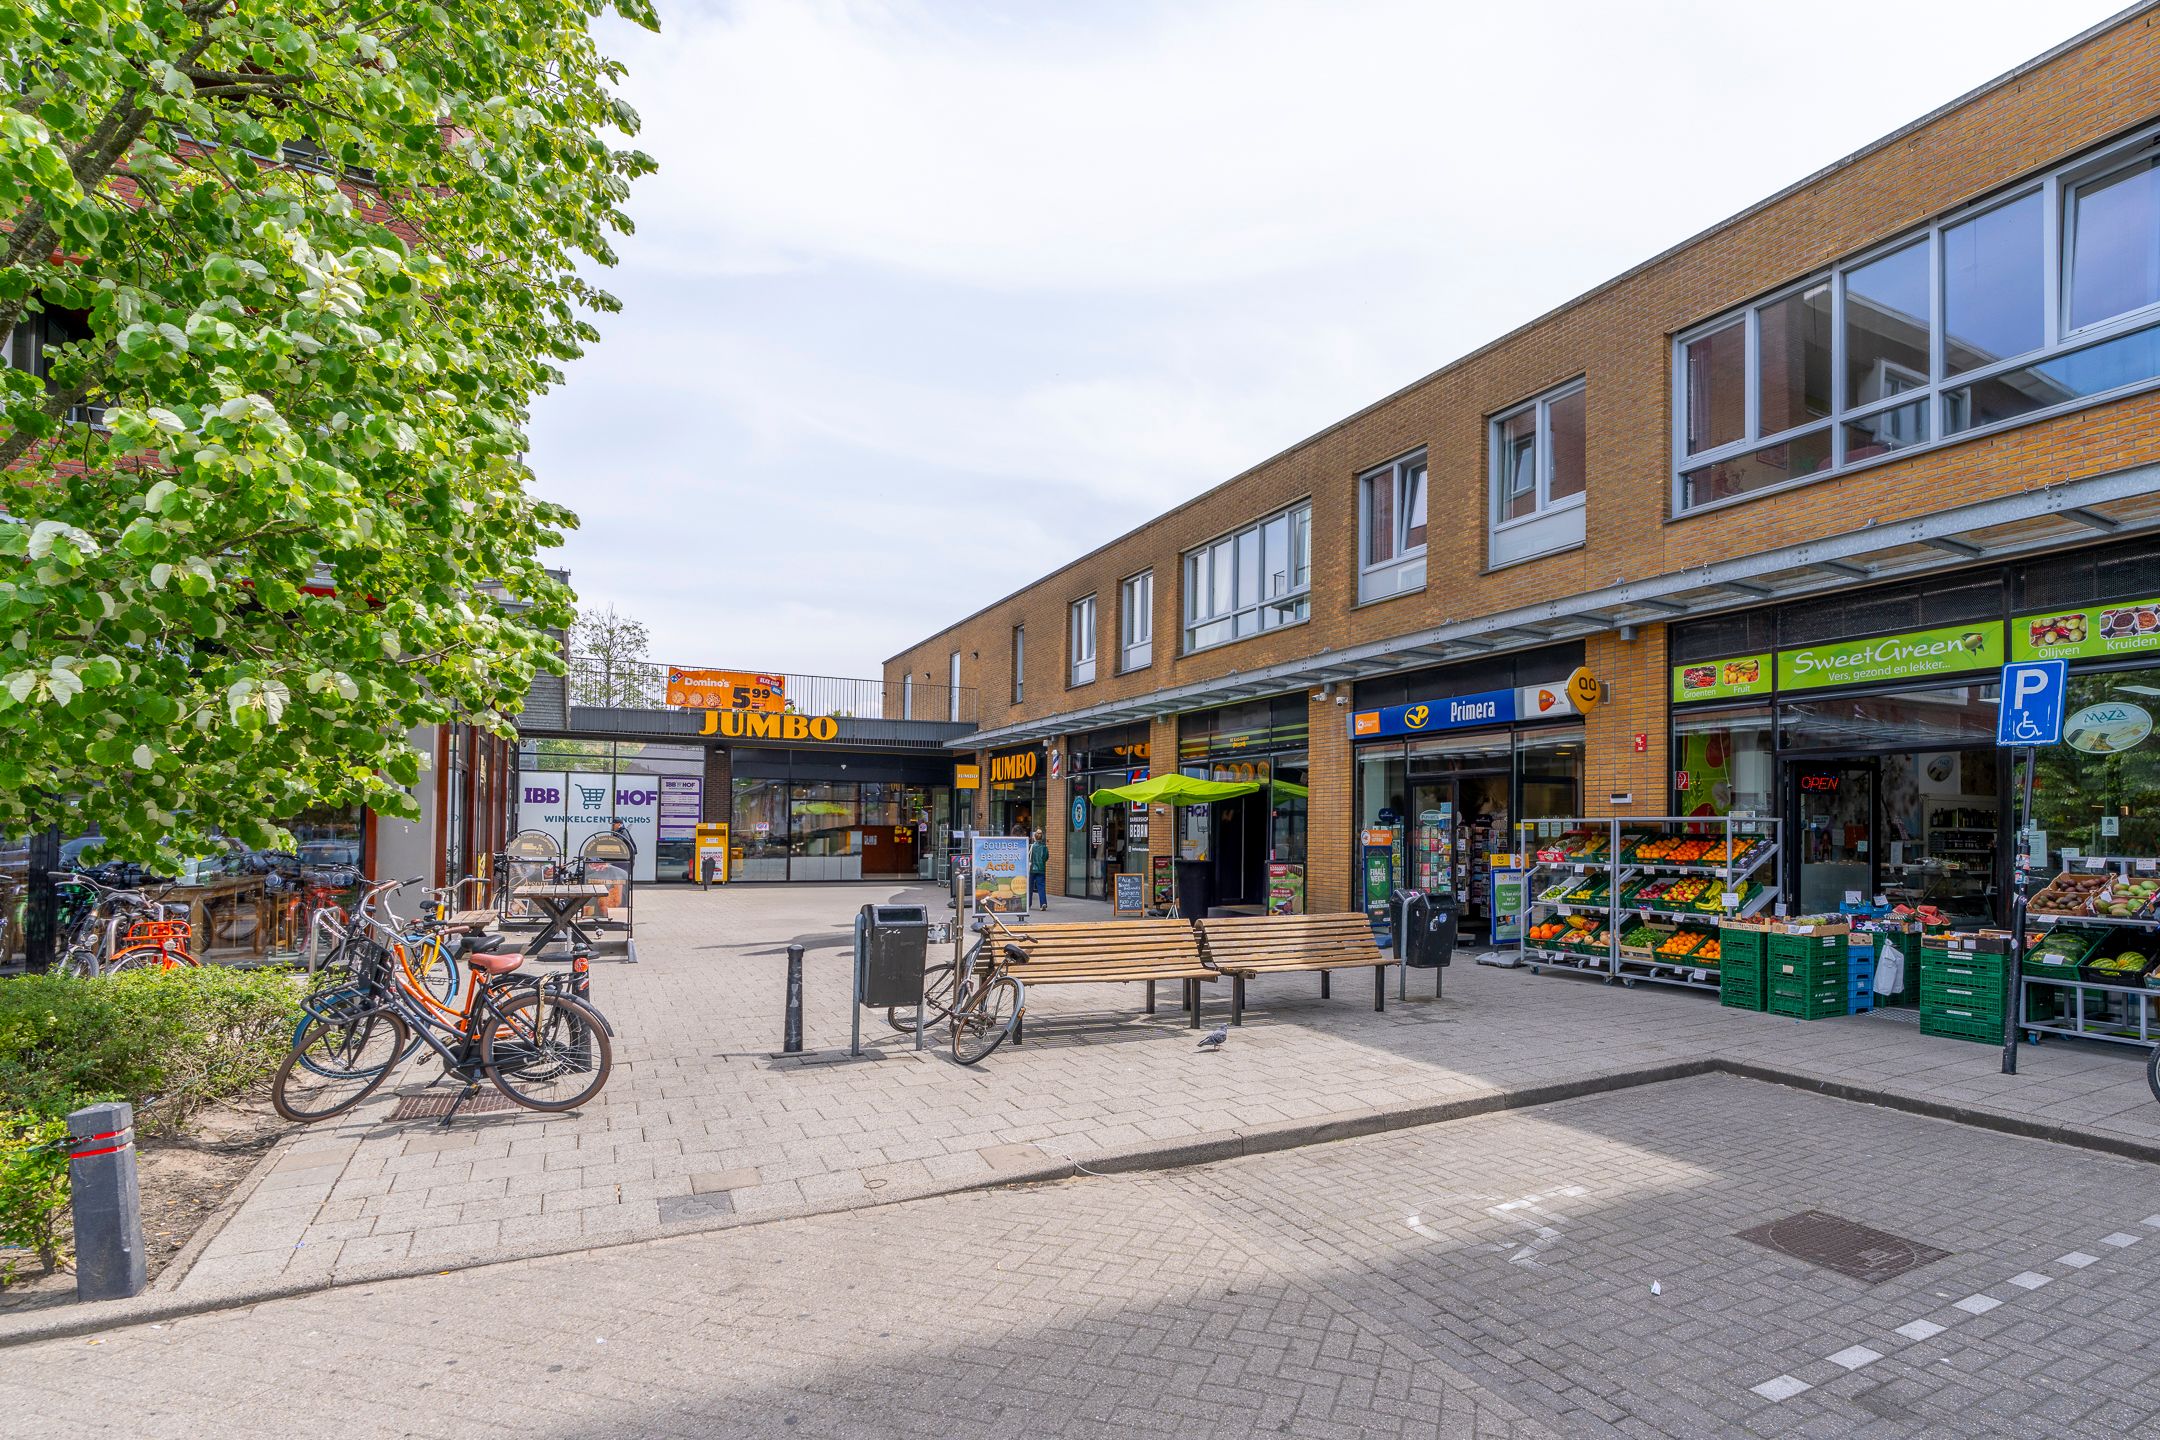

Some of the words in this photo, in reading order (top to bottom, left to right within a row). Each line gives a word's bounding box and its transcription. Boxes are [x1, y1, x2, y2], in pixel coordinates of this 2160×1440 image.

[2038, 646, 2080, 659] Olijven
[2106, 636, 2158, 651] Kruiden
[1794, 637, 1964, 674] SweetGreen
[685, 677, 730, 689] Domino's
[1828, 671, 1850, 683] Vers,
[1853, 666, 1891, 681] gezond
[1893, 665, 1907, 675] en
[1683, 687, 1716, 699] Groenten
[1733, 683, 1751, 694] Fruit
[2014, 668, 2049, 710] P
[1450, 701, 1496, 722] Primera
[698, 710, 839, 741] JUMBO
[990, 751, 1036, 782] JUMBO
[1801, 776, 1839, 790] OPEN
[524, 787, 560, 804] IBB
[616, 789, 657, 806] HOF
[985, 861, 1015, 871] Actie
